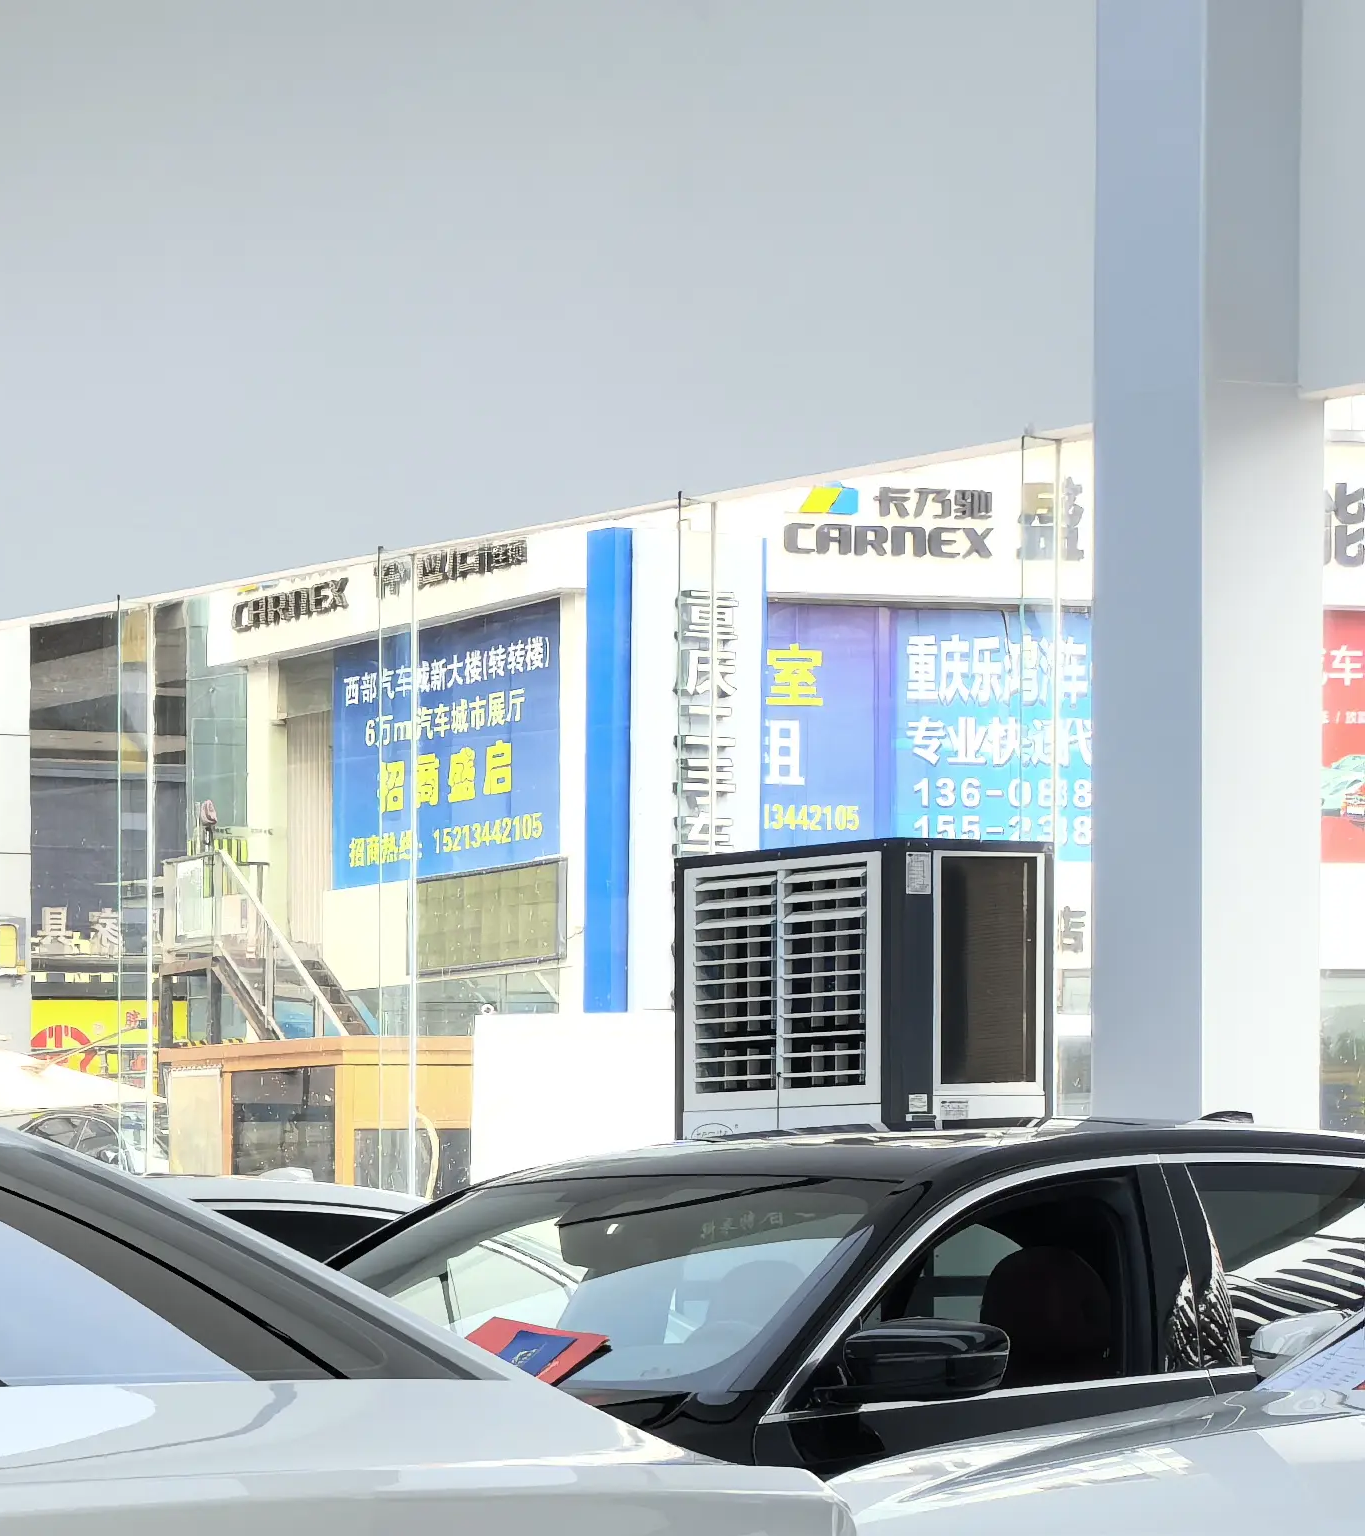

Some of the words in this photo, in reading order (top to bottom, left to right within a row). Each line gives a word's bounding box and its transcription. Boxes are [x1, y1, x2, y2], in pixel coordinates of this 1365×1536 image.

[783, 523, 994, 559] CARNEX
[231, 577, 350, 633] CARNEX
[765, 643, 824, 707] 室
[433, 813, 543, 853] 15213442105
